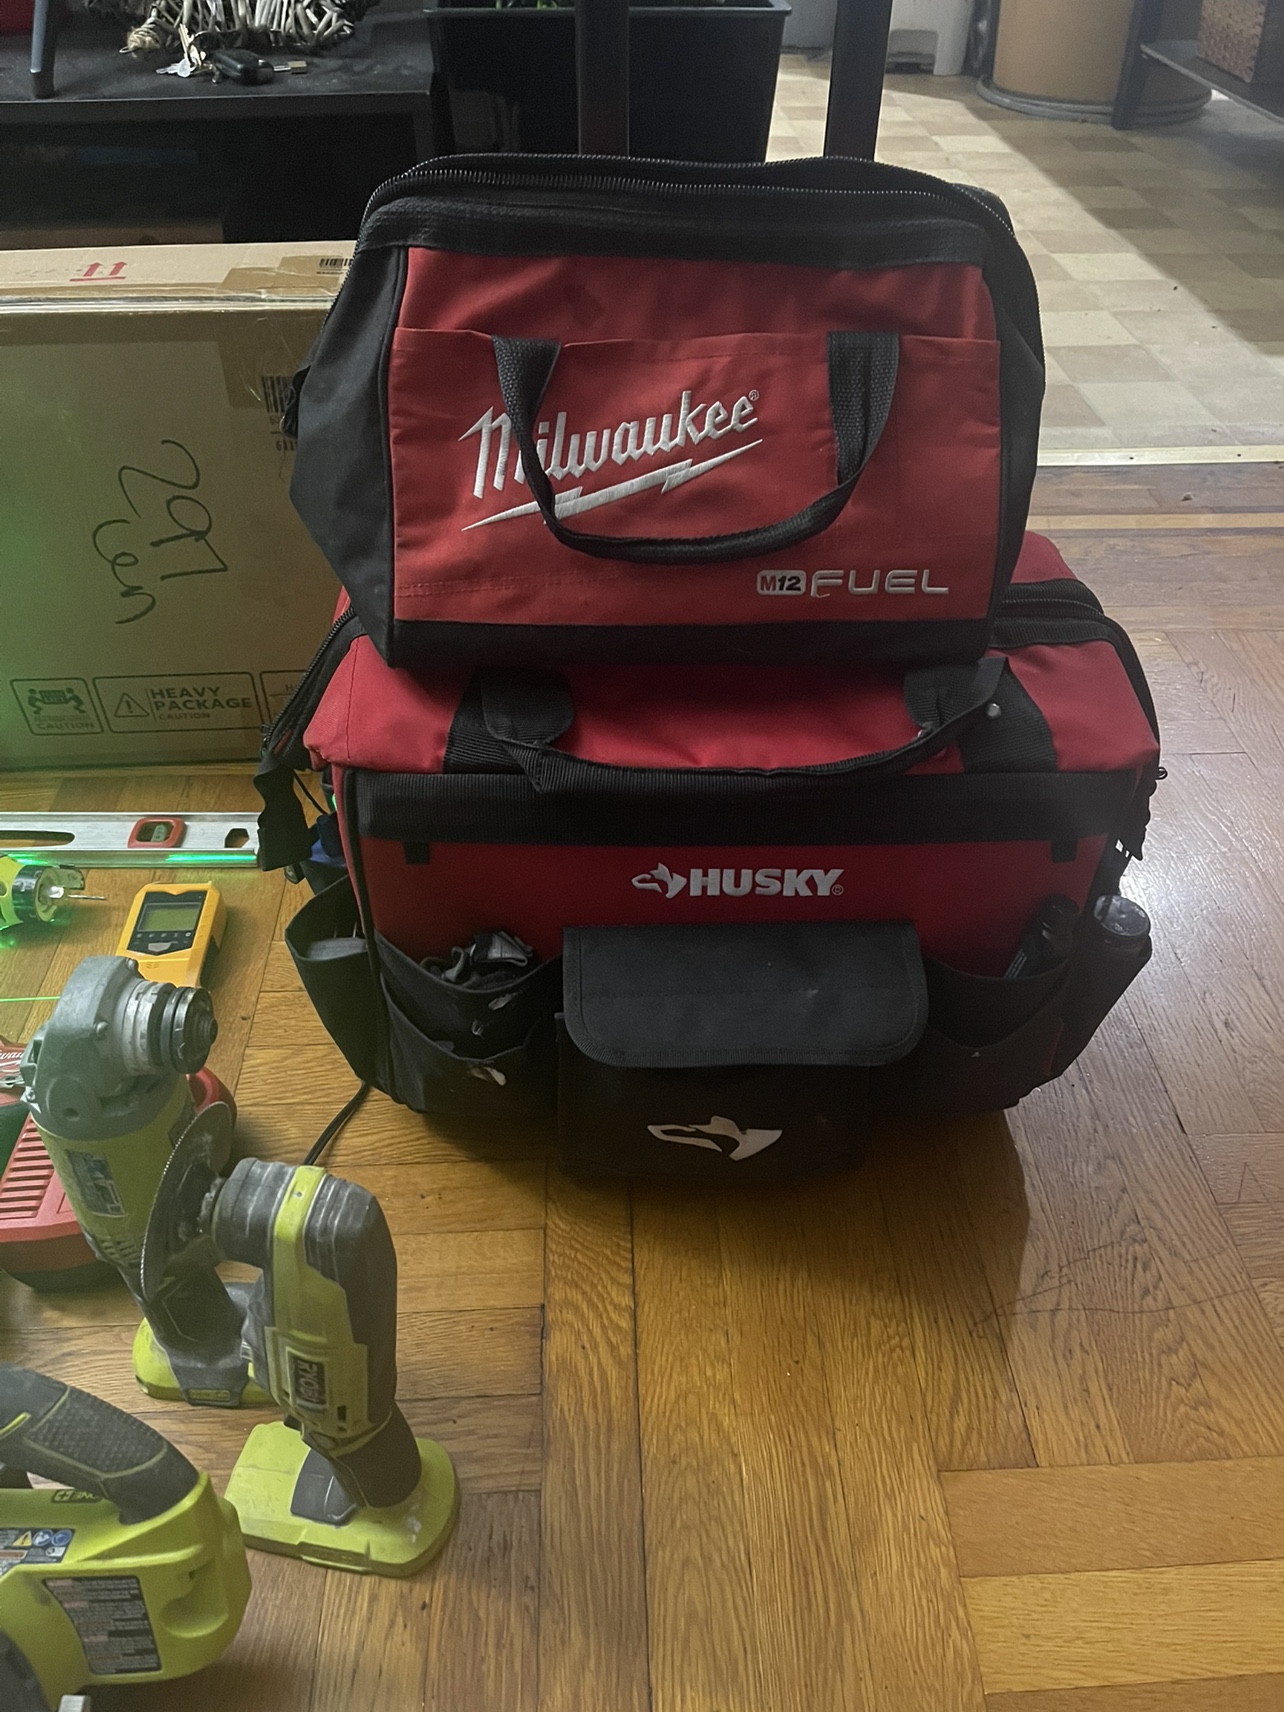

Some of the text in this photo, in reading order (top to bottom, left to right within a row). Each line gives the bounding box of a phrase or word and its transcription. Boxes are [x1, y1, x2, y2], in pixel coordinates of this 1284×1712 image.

[458, 390, 758, 499] Milwaukee
[759, 569, 949, 597] M12 FUEL
[151, 686, 220, 699] HEAVY
[155, 698, 252, 711] PACKAGE
[36, 721, 95, 731] CAUTION
[158, 711, 211, 721] CAUTION
[689, 868, 844, 897] HUSKY
[297, 1360, 321, 1403] RYOBI
